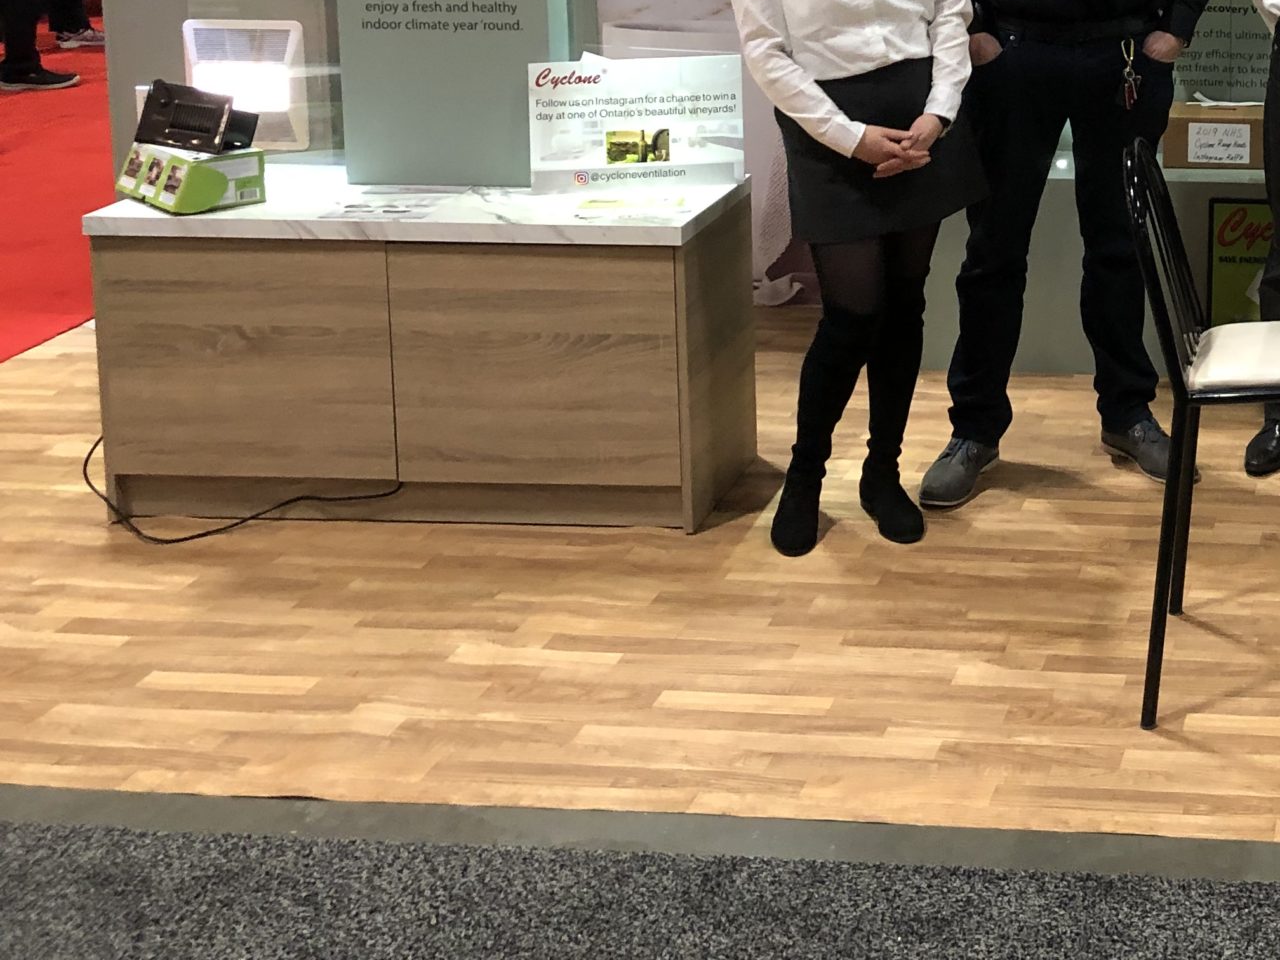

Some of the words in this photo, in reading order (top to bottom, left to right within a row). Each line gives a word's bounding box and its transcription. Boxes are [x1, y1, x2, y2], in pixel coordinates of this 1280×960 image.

[365, 1, 399, 14] enjoy
[402, 4, 409, 12] a
[412, 1, 442, 13] fresh
[445, 2, 469, 13] and
[472, 2, 517, 15] healthy
[361, 18, 401, 30] indoor
[405, 19, 449, 31] climate
[452, 21, 478, 33] year
[1203, 29, 1213, 38] of
[1216, 29, 1231, 38] the
[1234, 30, 1273, 40] ultimat
[1178, 50, 1203, 60] ergy
[1205, 49, 1253, 60] efficiency
[1256, 52, 1271, 60] an
[1195, 63, 1219, 73] fresh
[1222, 65, 1234, 73] air
[1237, 65, 1248, 74] to
[1250, 65, 1268, 74] kee
[535, 68, 602, 89] Cyclone
[1180, 78, 1224, 87] moisture
[1226, 79, 1257, 88] which
[535, 98, 567, 108] Follow
[568, 99, 580, 108] us
[581, 99, 594, 107] on
[595, 95, 644, 109] Instagram
[644, 94, 657, 104] for
[665, 93, 701, 103] chance
[702, 94, 712, 102] to
[713, 92, 729, 102] win
[536, 111, 553, 122] day
[555, 112, 565, 120] at
[567, 111, 585, 120] one
[588, 109, 597, 119] of
[599, 107, 643, 118] Ontario's
[645, 106, 686, 117] beautiful
[688, 104, 736, 116] vineyards!
[1195, 126, 1218, 136] 2019
[590, 168, 686, 182] @cycloneventilation
